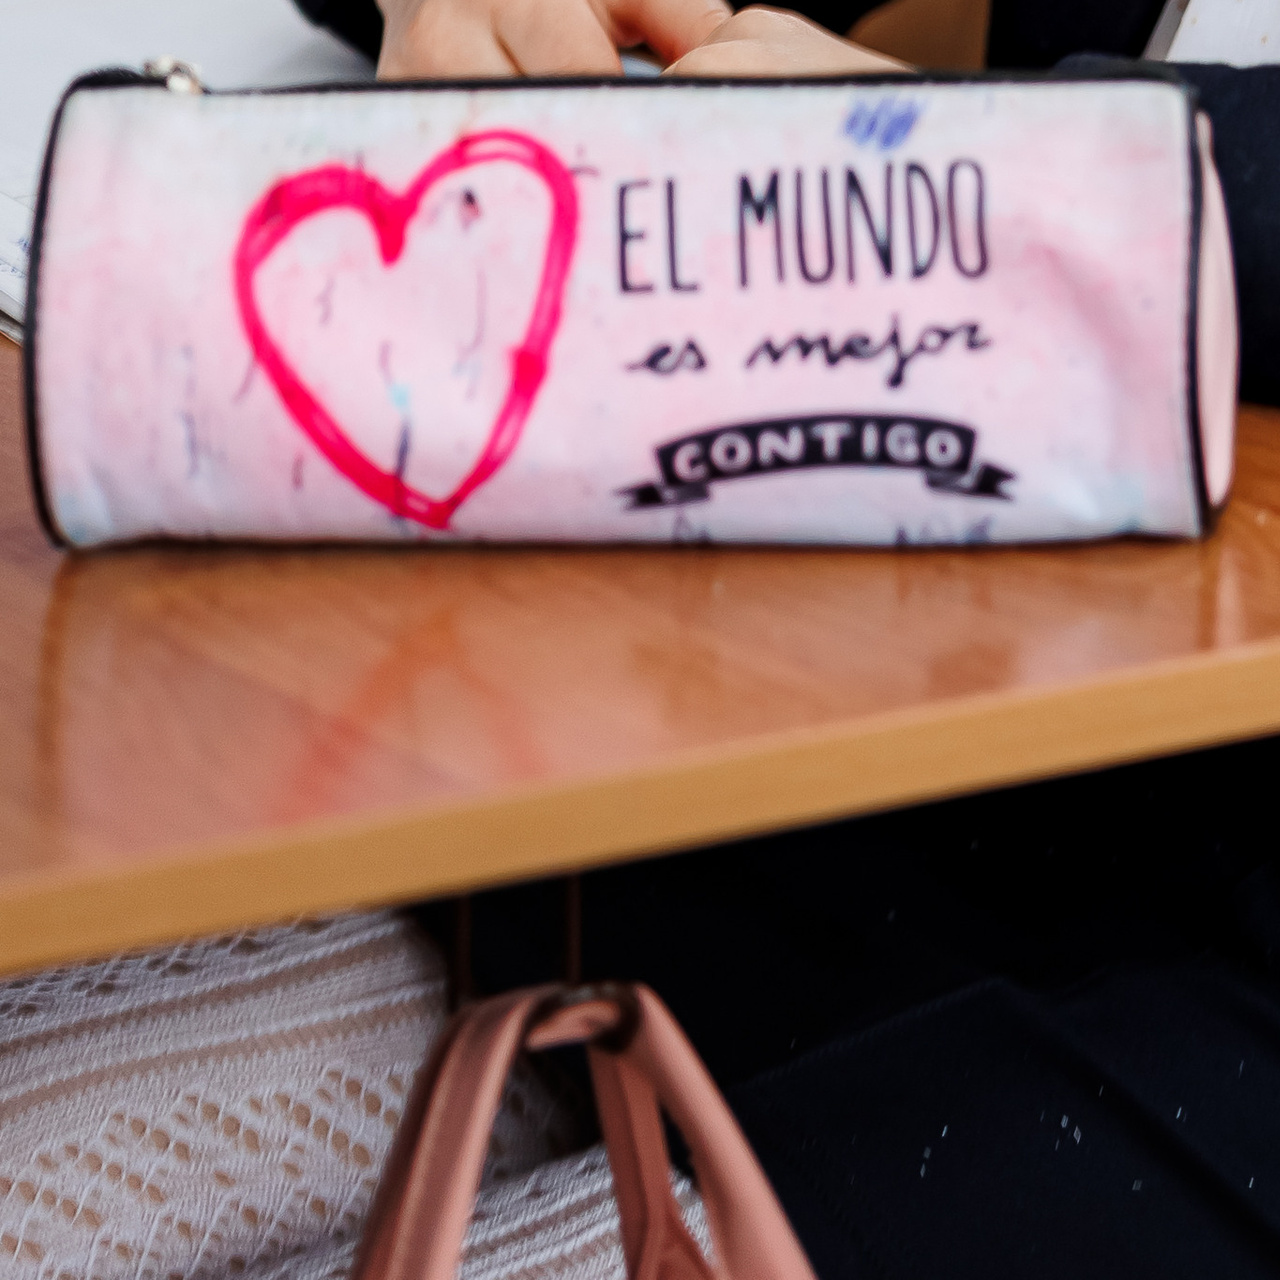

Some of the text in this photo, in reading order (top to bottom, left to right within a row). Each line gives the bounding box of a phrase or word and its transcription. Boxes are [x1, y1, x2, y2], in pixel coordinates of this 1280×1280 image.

[616, 158, 990, 294] EL MUNDO
[625, 312, 994, 389] es mejor
[671, 421, 965, 483] CONTIGO
